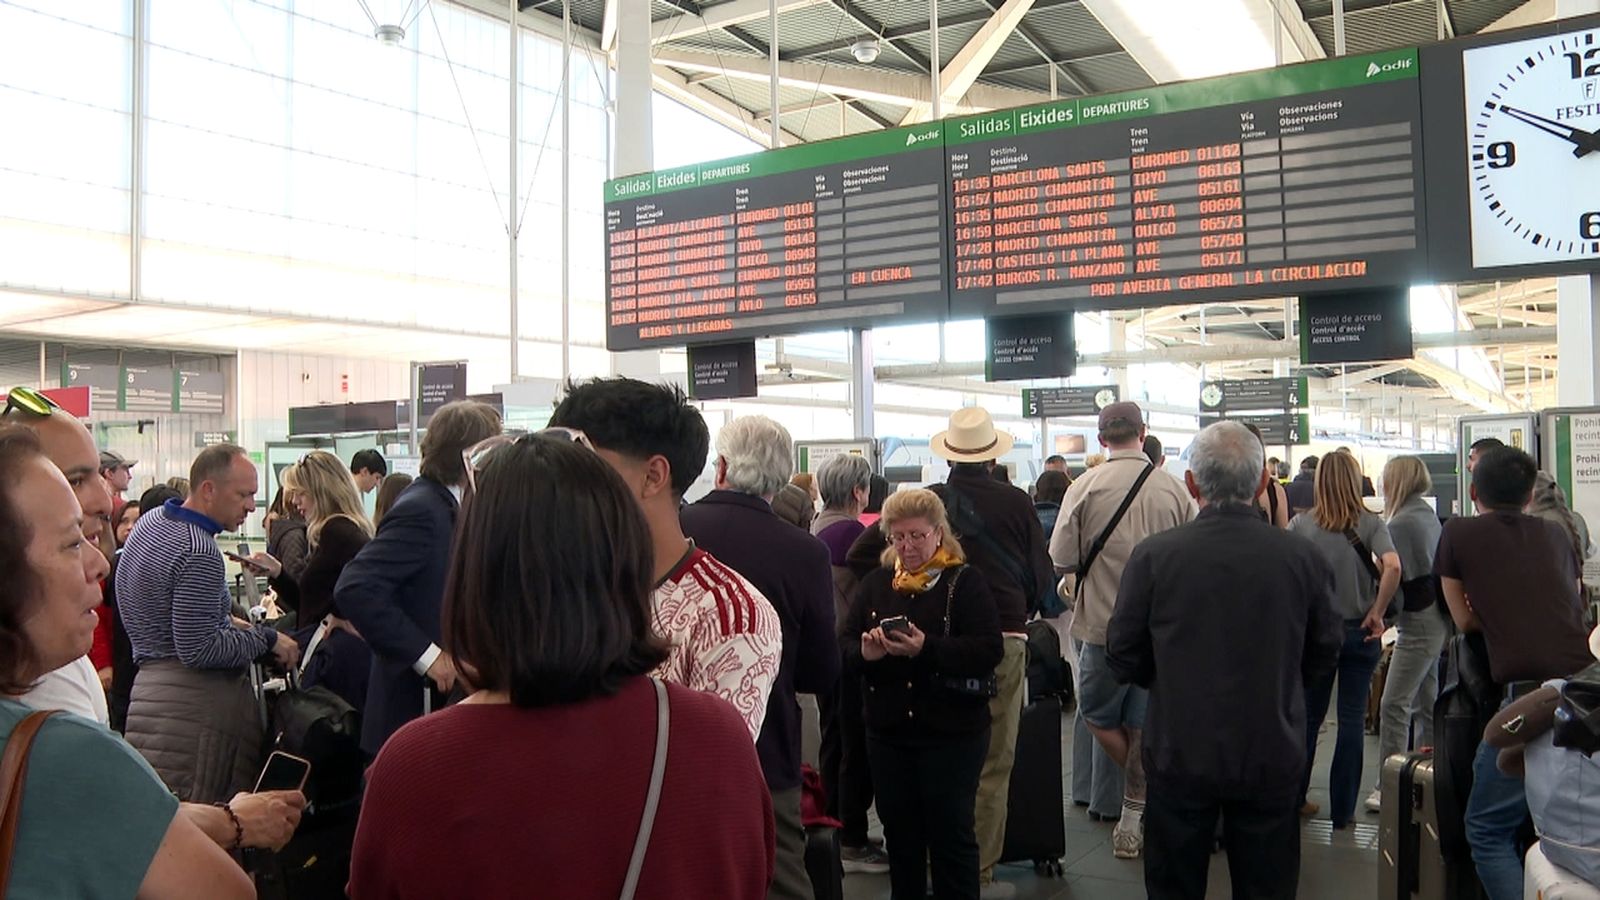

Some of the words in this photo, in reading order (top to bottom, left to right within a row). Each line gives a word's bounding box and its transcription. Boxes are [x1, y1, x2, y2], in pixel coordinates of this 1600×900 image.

[1381, 58, 1412, 72] adif
[1563, 48, 1600, 79] 12
[1585, 83, 1593, 98] F
[1279, 100, 1343, 116] Observaciones
[960, 117, 1010, 137] Salidas
[1020, 108, 1073, 128] Eixides
[1083, 98, 1149, 118] DEPARTURES
[1279, 111, 1338, 127] Observacions
[917, 130, 939, 141] adif
[1130, 127, 1148, 136] Tren
[1131, 136, 1149, 146] Tren
[951, 153, 968, 162] Hora
[990, 146, 1017, 157] Destino
[1487, 141, 1516, 169] 9
[952, 162, 968, 172] Hora
[953, 177, 990, 193] 15:35
[993, 167, 1060, 187] BARCELONA
[1067, 161, 1106, 177] SANTS
[1132, 150, 1189, 169] EUROMED
[1197, 143, 1240, 161] 01162
[990, 154, 1028, 167] Destinació
[843, 165, 889, 178] Observaciones
[614, 180, 651, 196] Salidas
[657, 172, 696, 188] Eixides
[702, 163, 750, 180] DEPARTURES
[993, 186, 1038, 204] MADRID
[1133, 170, 1166, 186] IRYO
[955, 209, 991, 225] 16:35
[993, 203, 1038, 220] MADRID
[1134, 188, 1158, 203] AVE
[737, 207, 778, 224] EUROMED
[955, 226, 992, 241] 16:59
[994, 217, 1061, 237] BARCELONA
[1069, 211, 1108, 227] SANTS
[1134, 204, 1176, 221] ALVIA
[1580, 212, 1600, 239] 6
[637, 239, 670, 253] MADRID
[738, 225, 757, 238] AVE
[995, 236, 1040, 253] MADRID
[1135, 222, 1176, 238] OUIGO
[637, 252, 670, 267] MADRID
[1062, 249, 1077, 263] LA
[1085, 244, 1124, 260] PLANA
[1136, 241, 1160, 256] AVE
[638, 266, 670, 280] MADRID
[957, 275, 993, 290] 17:42
[996, 270, 1041, 286] BURGOS
[1047, 268, 1061, 281] R.
[1070, 262, 1125, 279] MANZANO
[1136, 258, 1160, 273] AVE
[1201, 251, 1244, 268] 05171
[638, 279, 686, 295] BARCELONA
[691, 274, 720, 288] SANTS
[738, 267, 780, 282] EUROMED
[638, 293, 671, 308] MADRID
[739, 284, 756, 297] AVE
[851, 271, 866, 285] EN
[871, 266, 912, 282] CUENCA
[1090, 282, 1116, 297] POR
[1122, 279, 1171, 295] AVERIA
[1179, 275, 1235, 290] GENERAL
[1245, 271, 1264, 284] LA
[638, 307, 671, 322] MADRID
[739, 298, 763, 311] AVLO
[676, 323, 684, 334] Y
[687, 319, 732, 334] LLEGADAS
[1310, 315, 1340, 325] Control
[1341, 315, 1352, 323] de
[1354, 314, 1382, 322] acceso
[1311, 326, 1337, 335] Control
[994, 338, 1017, 346] Control
[1019, 337, 1028, 345] de
[1030, 336, 1052, 344] acceso
[1312, 336, 1333, 344] ACCESS
[1334, 335, 1360, 343] CONTROL
[994, 347, 1015, 355] Control
[70, 370, 77, 380] 9
[128, 373, 135, 383] 8
[181, 376, 188, 386] 7
[1289, 393, 1298, 405] 4
[1030, 403, 1037, 414] 5
[1289, 429, 1299, 442] 4
